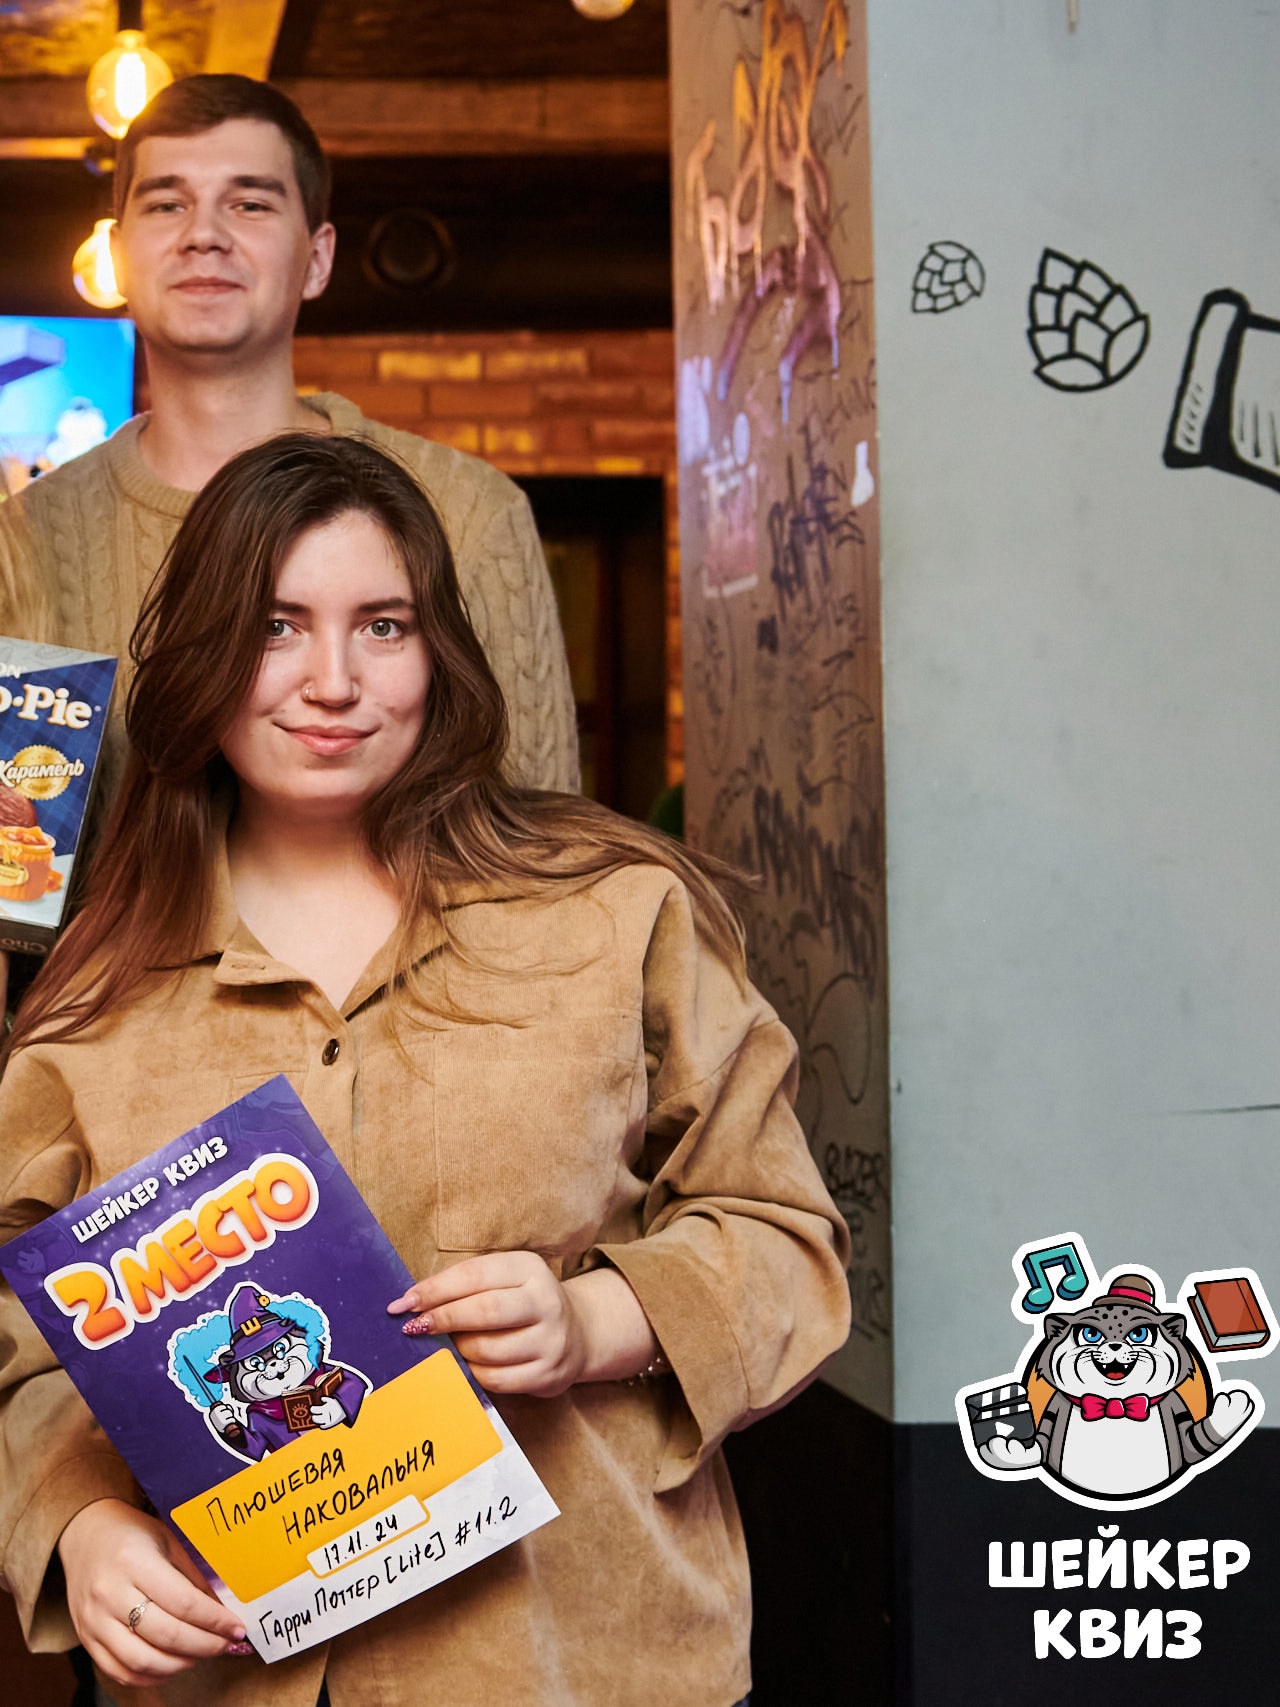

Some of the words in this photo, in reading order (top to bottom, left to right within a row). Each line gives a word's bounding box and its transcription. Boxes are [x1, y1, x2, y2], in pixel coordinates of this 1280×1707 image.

[51, 1269, 128, 1343] 2
[118, 1160, 312, 1316] МЕСТО
[70, 1177, 161, 1244] ШЕЙКЕР
[163, 1136, 228, 1187] КВИЗ
